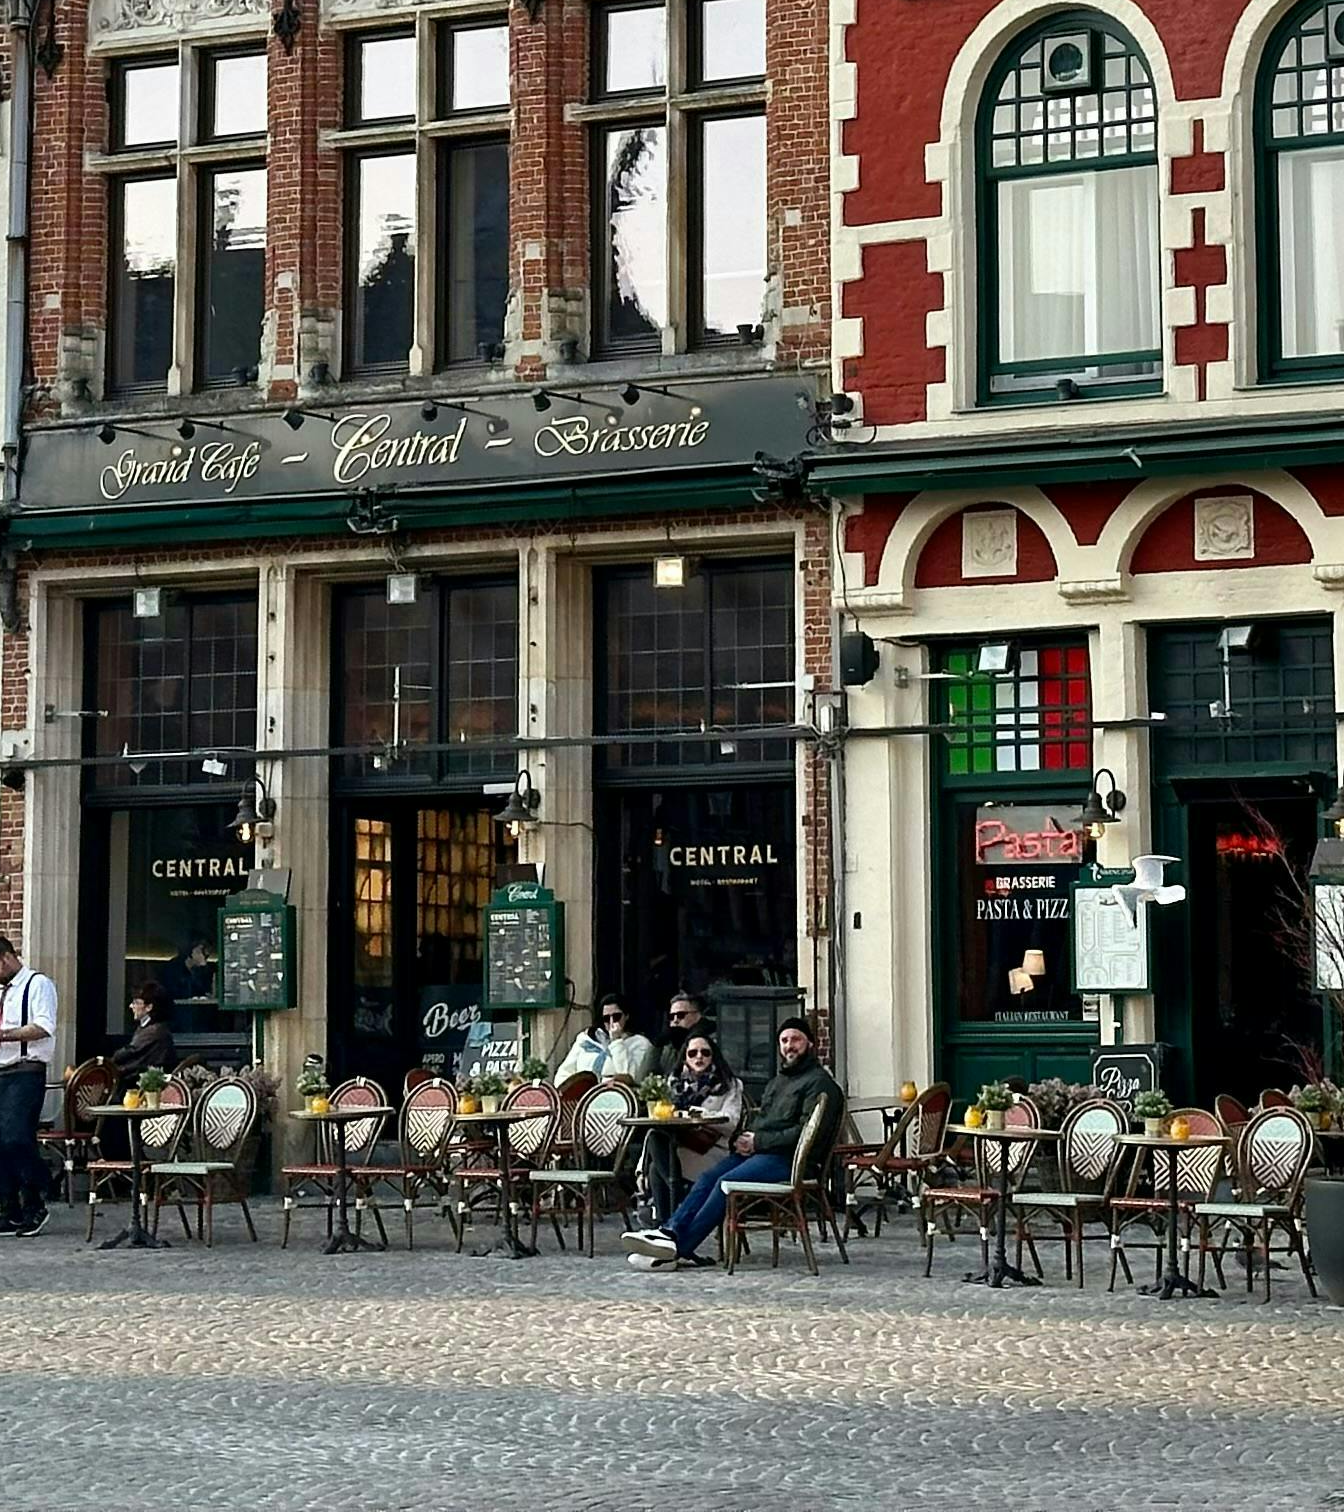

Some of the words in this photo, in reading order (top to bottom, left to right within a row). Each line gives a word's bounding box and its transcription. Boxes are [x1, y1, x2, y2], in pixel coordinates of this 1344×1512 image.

[99, 446, 197, 500] Grand
[330, 413, 468, 484] Central
[534, 414, 710, 457] Brasserie
[976, 815, 1078, 864] Pasta
[152, 856, 249, 878] CENTRAL
[669, 844, 778, 867] CENTRAL
[995, 875, 1056, 890] BRASSERIE
[976, 898, 1020, 920] PASTA
[1022, 898, 1033, 920] &
[422, 1002, 481, 1038] Beer
[481, 1040, 519, 1058] PIZZA
[1099, 1066, 1140, 1099] Pizza
